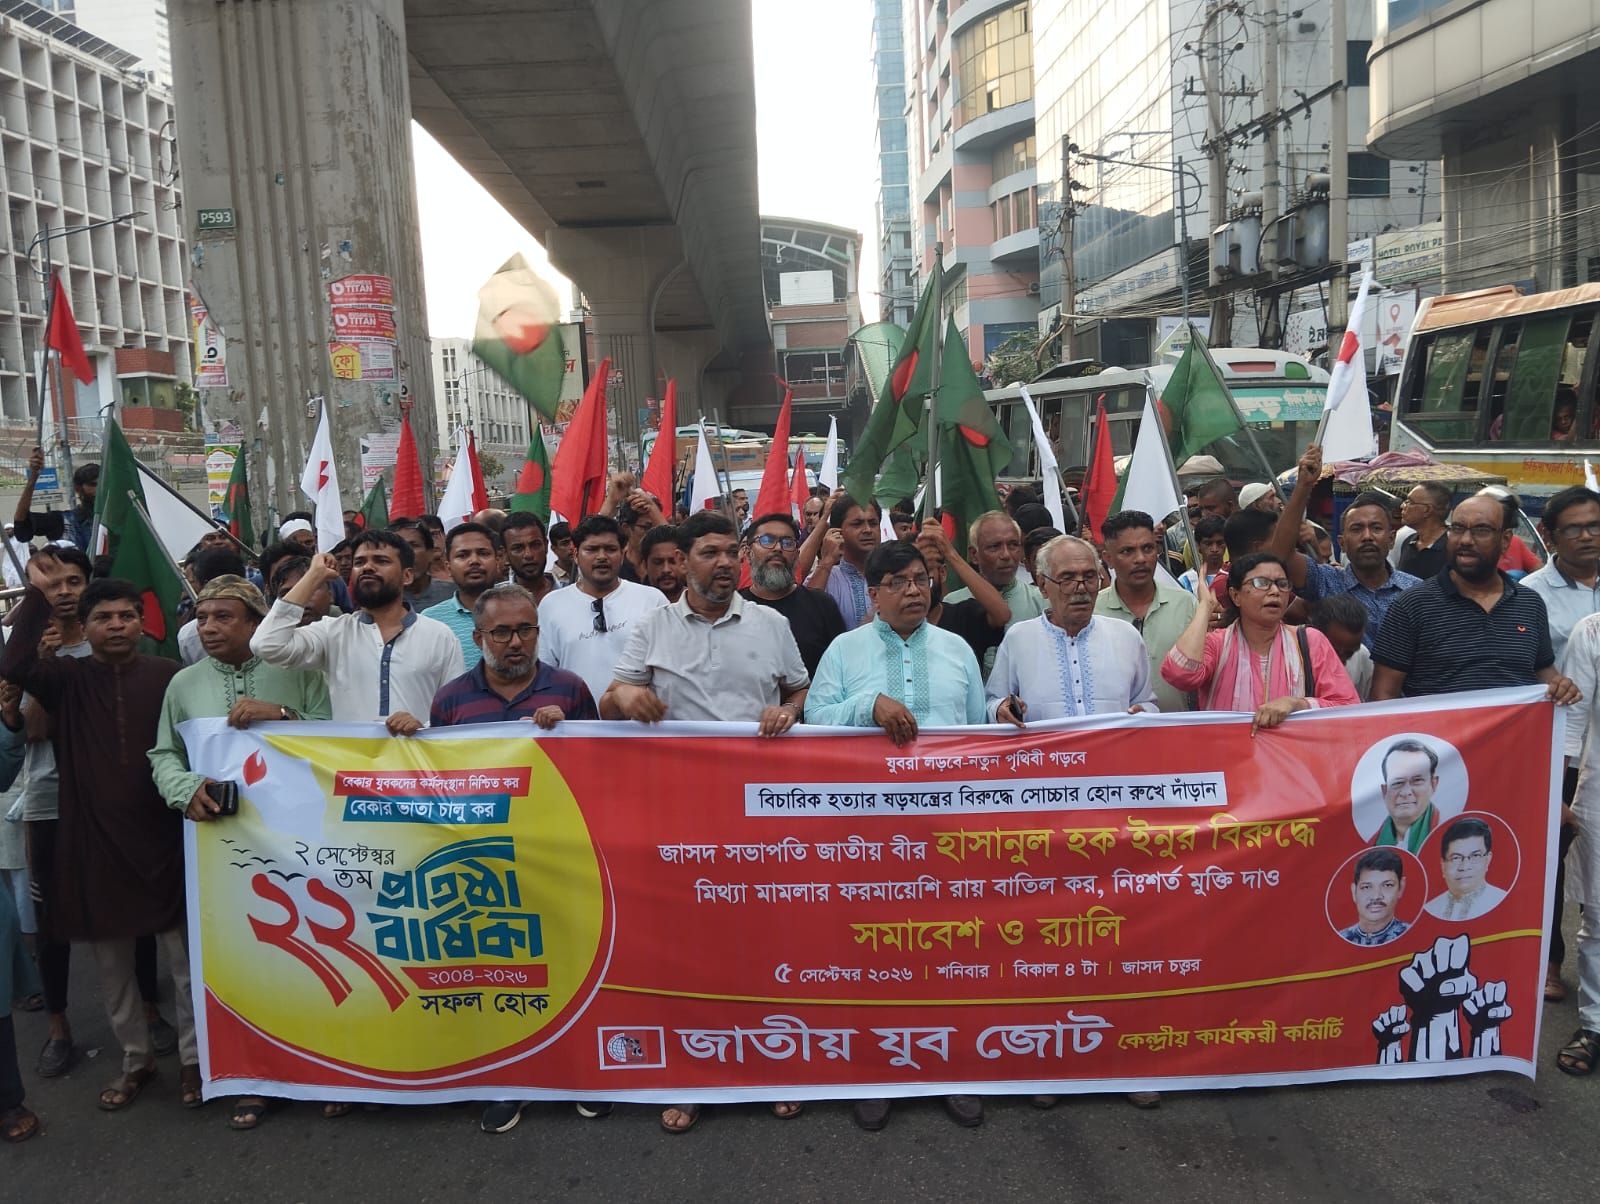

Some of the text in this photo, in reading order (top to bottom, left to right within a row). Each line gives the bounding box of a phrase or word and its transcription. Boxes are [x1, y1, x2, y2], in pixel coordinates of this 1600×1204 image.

[201, 212, 231, 224] P593
[1378, 247, 1401, 257] HOTEL
[345, 285, 373, 293] TITAN
[349, 317, 377, 326] TITAN
[885, 756, 918, 774] যুবরা
[1005, 749, 1043, 772] পৃথিবী
[1049, 751, 1087, 768] গড়বে
[343, 774, 520, 793] বেকার যুবকদের কর্মসংস্থান নিশ্চিত কর
[758, 777, 1217, 811] বিচারিক হত্যার ষড়যন্ত্রের বিরুদ্ধে সোচ্চার হোন রুখে দাঁড়ান
[350, 799, 496, 822] বেকার ভাতা চালু কর
[657, 812, 1321, 865] জাসদ সভাপতি জাতীয় বীর হাসানুল হক ইনুর বিরুদ্ধে
[295, 841, 395, 866] ২ সেপ্টেম্বর
[333, 869, 374, 889] তম
[694, 865, 1280, 904] মিথ্যা মামলার ফরমায়েশি রায় বাতিল কর, নিঃশর্ত মুক্তি দাও
[849, 915, 985, 952] সমাবেশ
[996, 921, 1025, 946] ও
[427, 969, 527, 985] ২০০৪-২০২৬
[775, 963, 793, 984] ৫
[799, 965, 861, 984] সেপ্টেম্বর
[868, 967, 913, 983] ২০২৬
[936, 962, 990, 979] শনিবার
[1012, 959, 1059, 977] বিকাল
[1064, 963, 1076, 977] ৪
[1080, 958, 1099, 977] টা
[1121, 959, 1163, 976] জাসদ
[418, 992, 550, 1016] সফল হোক
[673, 1009, 1345, 1070] জাতীয় যুব জোট কেন্দ্রীয় কার্যকরী কমিটি
